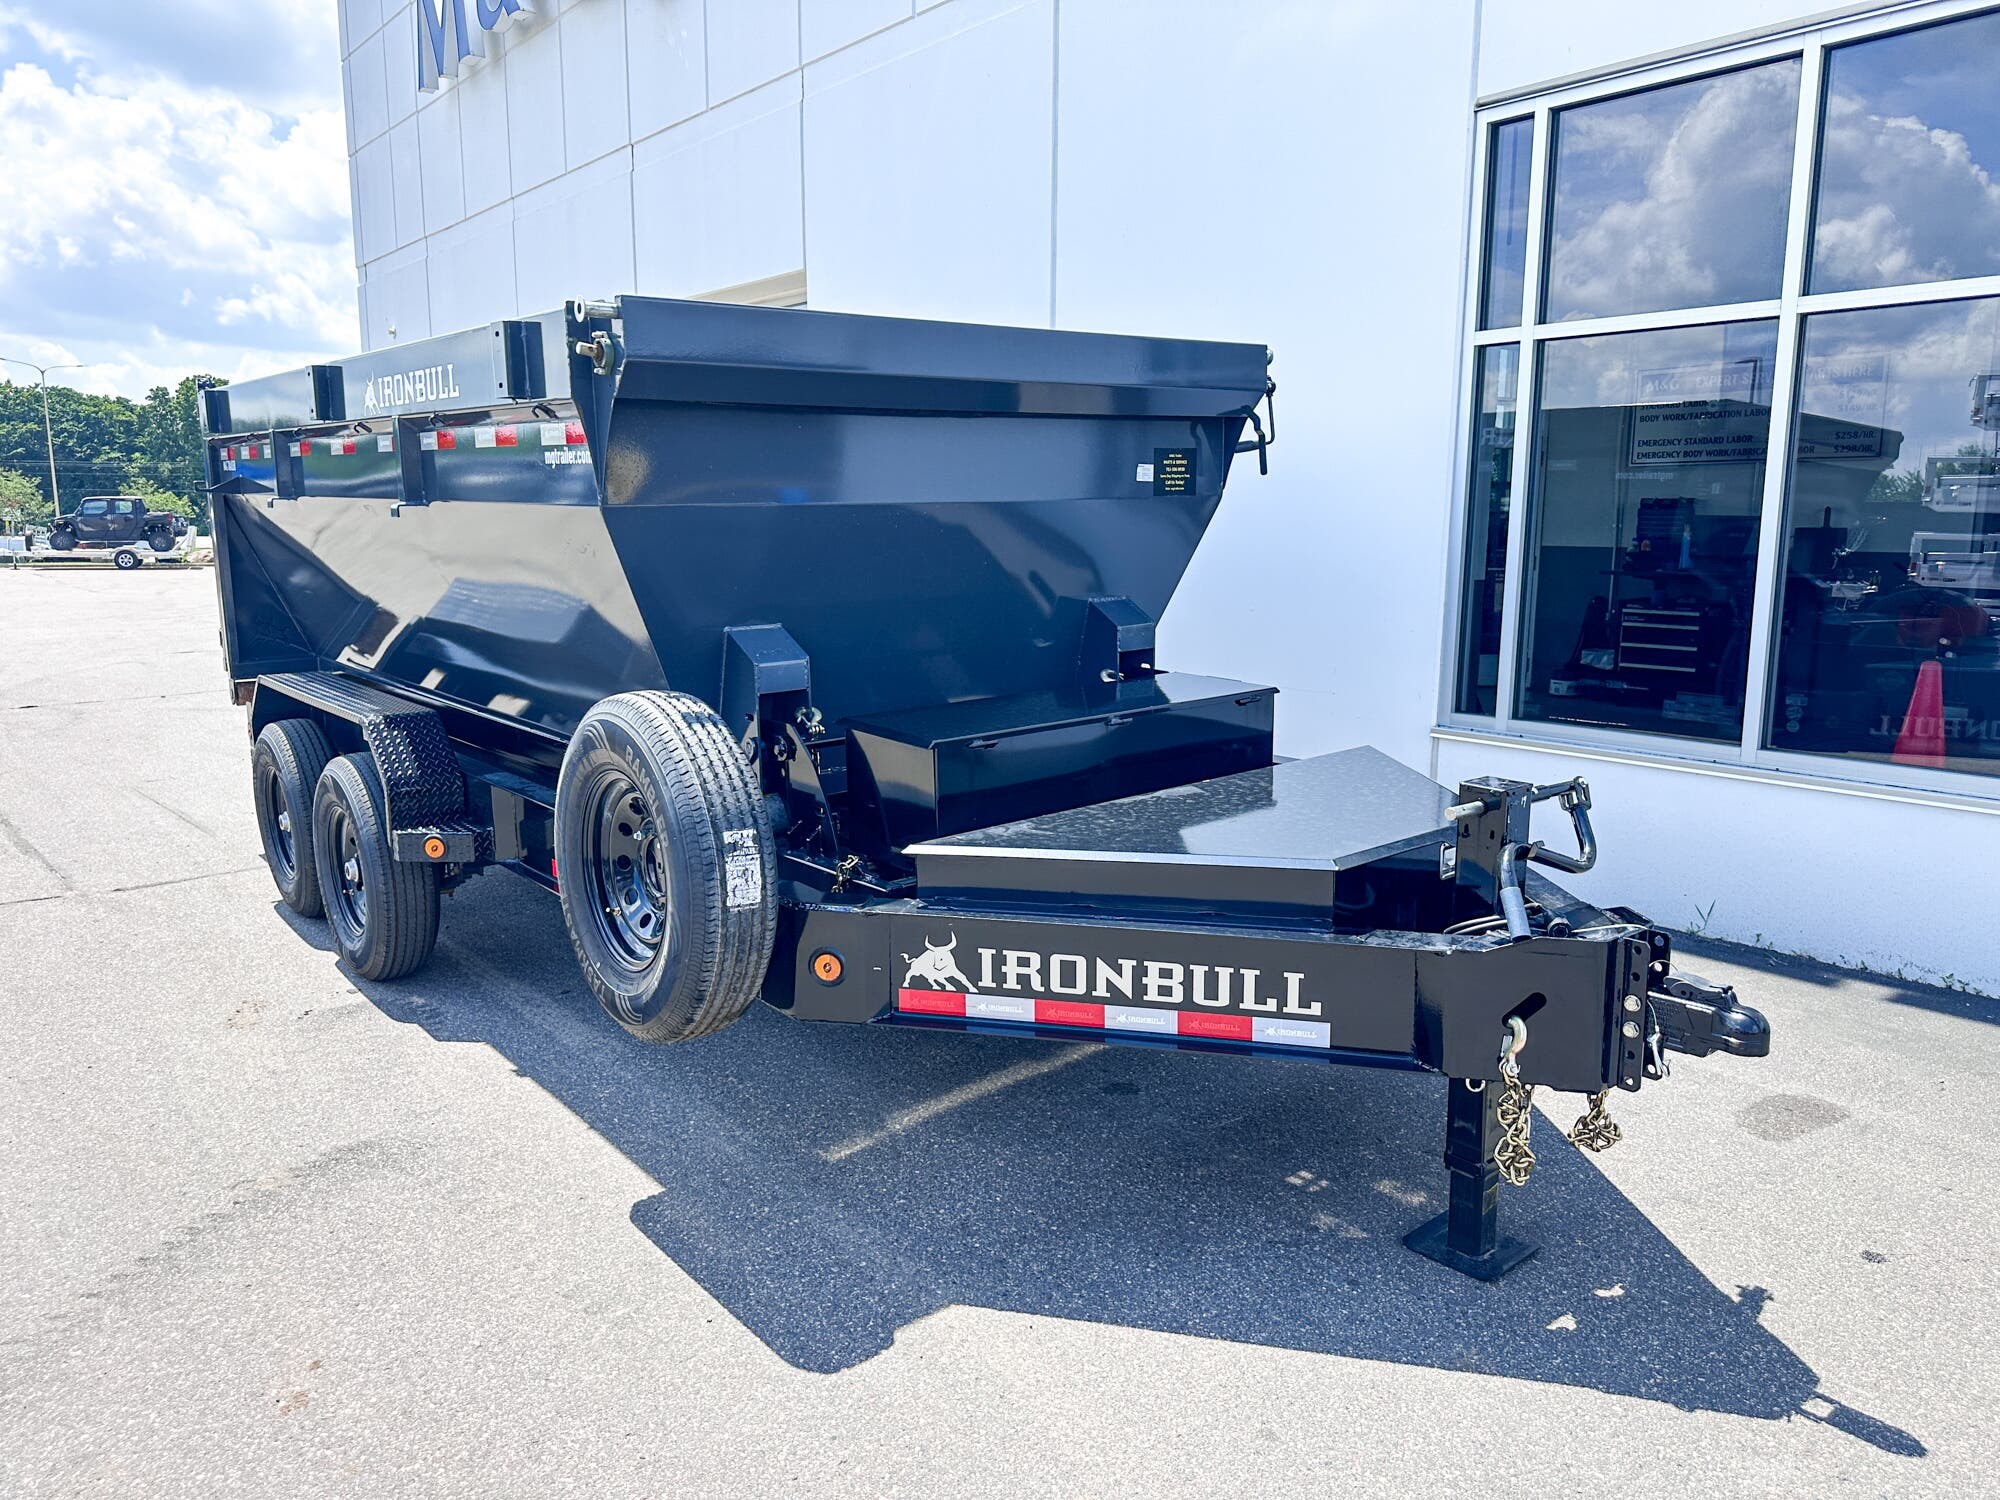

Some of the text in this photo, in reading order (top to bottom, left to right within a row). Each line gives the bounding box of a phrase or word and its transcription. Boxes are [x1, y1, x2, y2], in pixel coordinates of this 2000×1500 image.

[377, 363, 460, 408] IRONBULL
[1640, 414, 1659, 423] BODY
[1662, 409, 1741, 421] WORK/FABRICATION
[1636, 450, 1681, 460] EMERGENCY
[1683, 449, 1704, 459] BODY
[1705, 447, 1768, 458] WORK/FABRICA
[1637, 438, 1681, 448] EMERGENCY
[1683, 436, 1724, 446] STANDARD
[1726, 434, 1754, 444] LABOR
[625, 744, 669, 848] RAMBLER
[977, 947, 1322, 1017] IRONBULL
